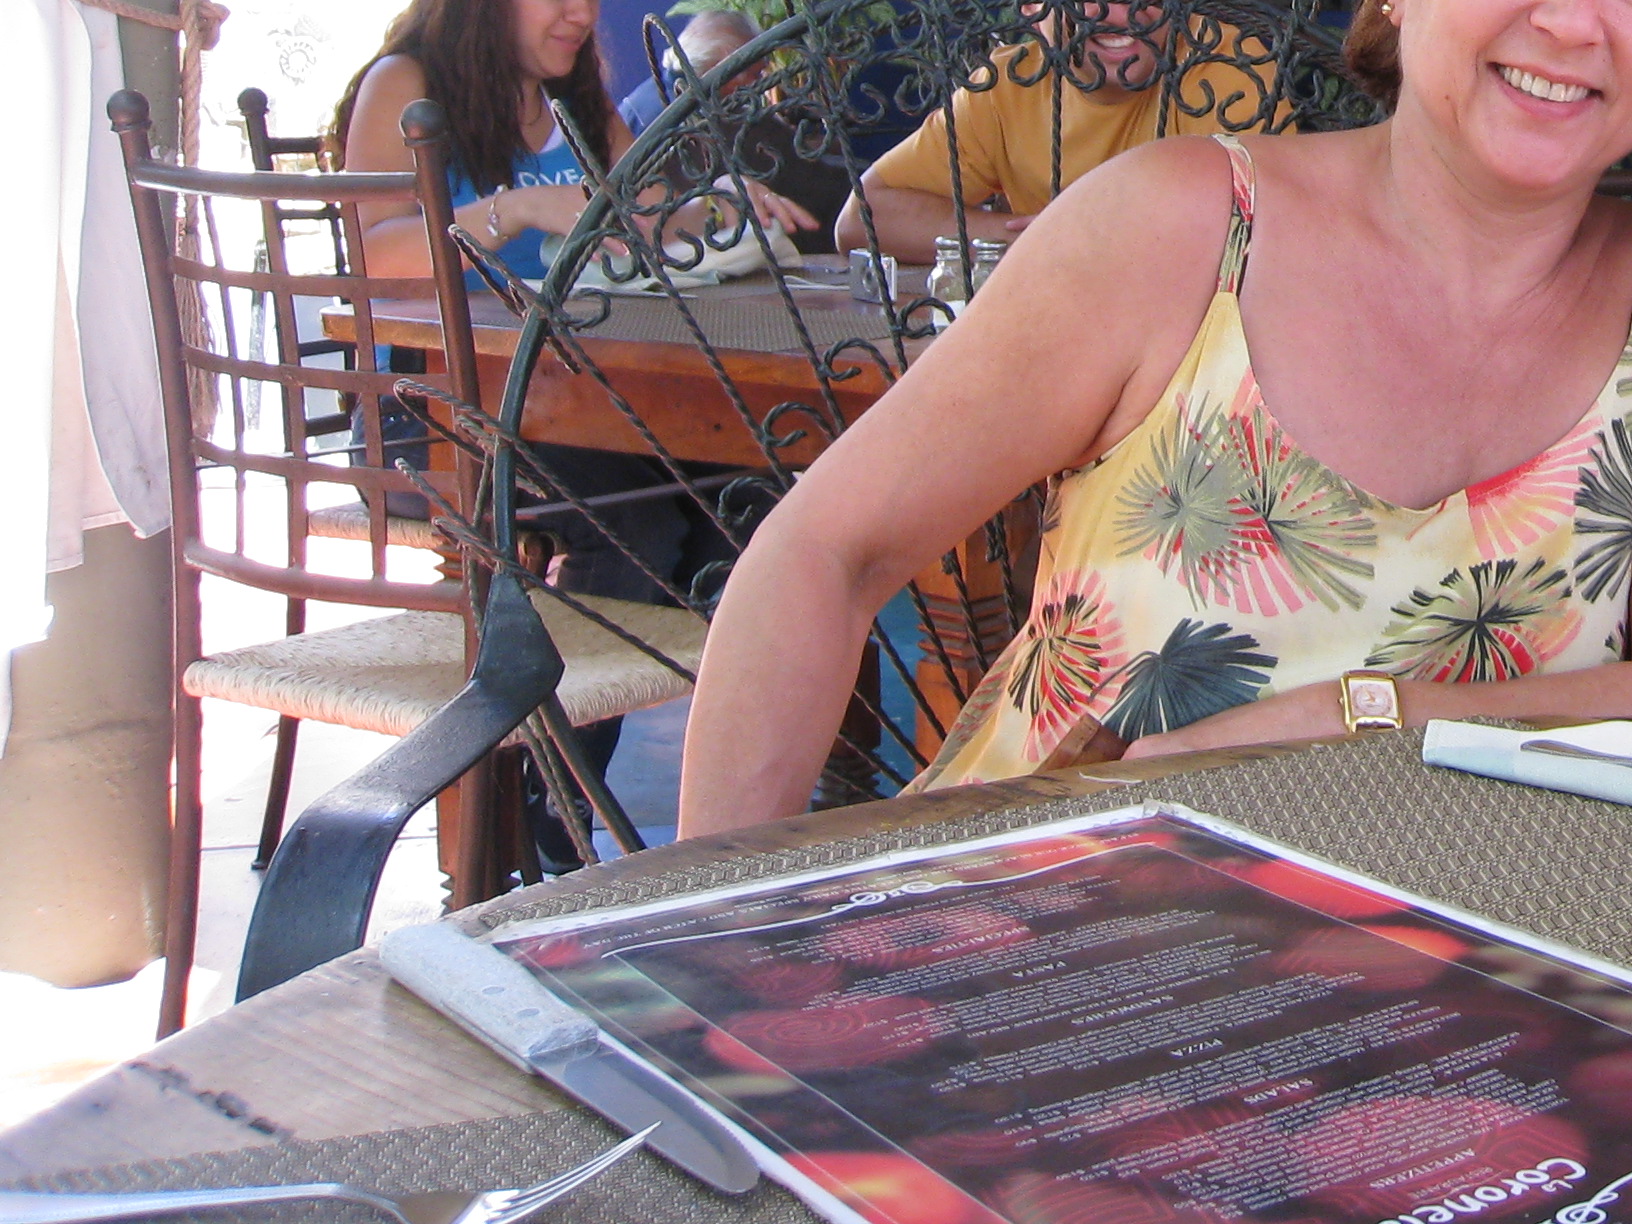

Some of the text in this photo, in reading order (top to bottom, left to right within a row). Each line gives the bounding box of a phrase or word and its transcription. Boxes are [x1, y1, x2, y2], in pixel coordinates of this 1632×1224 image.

[1166, 1037, 1225, 1056] PIZZA
[1239, 1077, 1316, 1104] SALADS
[1367, 1146, 1475, 1189] APPETIZERS
[1377, 1157, 1585, 1223] Corone
[1540, 1178, 1572, 1191] La
